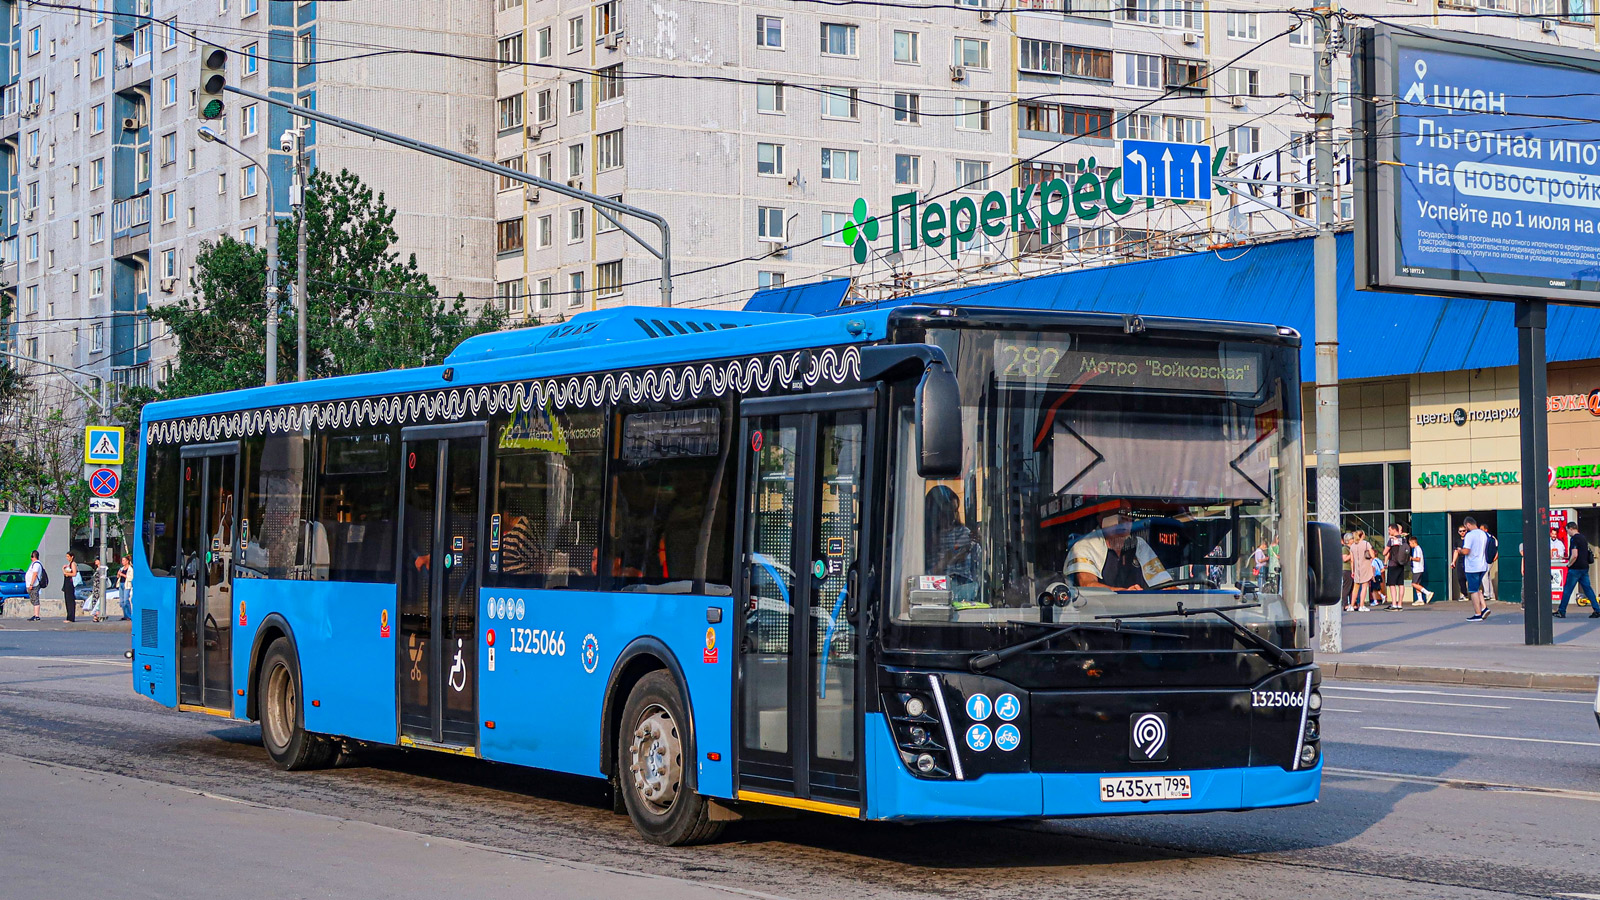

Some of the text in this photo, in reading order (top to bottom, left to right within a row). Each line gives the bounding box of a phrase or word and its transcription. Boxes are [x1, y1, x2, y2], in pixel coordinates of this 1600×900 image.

[1433, 84, 1505, 116] циан
[1415, 118, 1600, 166] Льготная ипо
[1417, 161, 1451, 187] на
[890, 146, 1230, 260] Перекрёск
[1417, 200, 1488, 224] Успейте
[1491, 209, 1512, 229] до
[1515, 210, 1524, 227] 1
[1528, 214, 1570, 232] июля
[1574, 218, 1594, 234] на
[1417, 229, 1468, 241] Государственная
[1468, 234, 1501, 244] программа
[1502, 238, 1530, 246] льготного
[1531, 241, 1564, 249] ипотечного
[1466, 243, 1509, 252] строительство
[1472, 250, 1491, 258] услуги
[1500, 252, 1524, 260] ипотеке
[1529, 255, 1552, 263] условия
[1553, 257, 1598, 266] предоставления
[1002, 345, 1250, 381] 282 Метро "Войковская"
[1546, 394, 1587, 412] ЗБУКА
[1415, 412, 1452, 426] цветы
[498, 423, 522, 449] 282
[1430, 469, 1519, 489] Перекрёсток
[509, 627, 566, 657] 1325066
[1251, 691, 1304, 708] 1325066
[1164, 777, 1187, 791] 799
